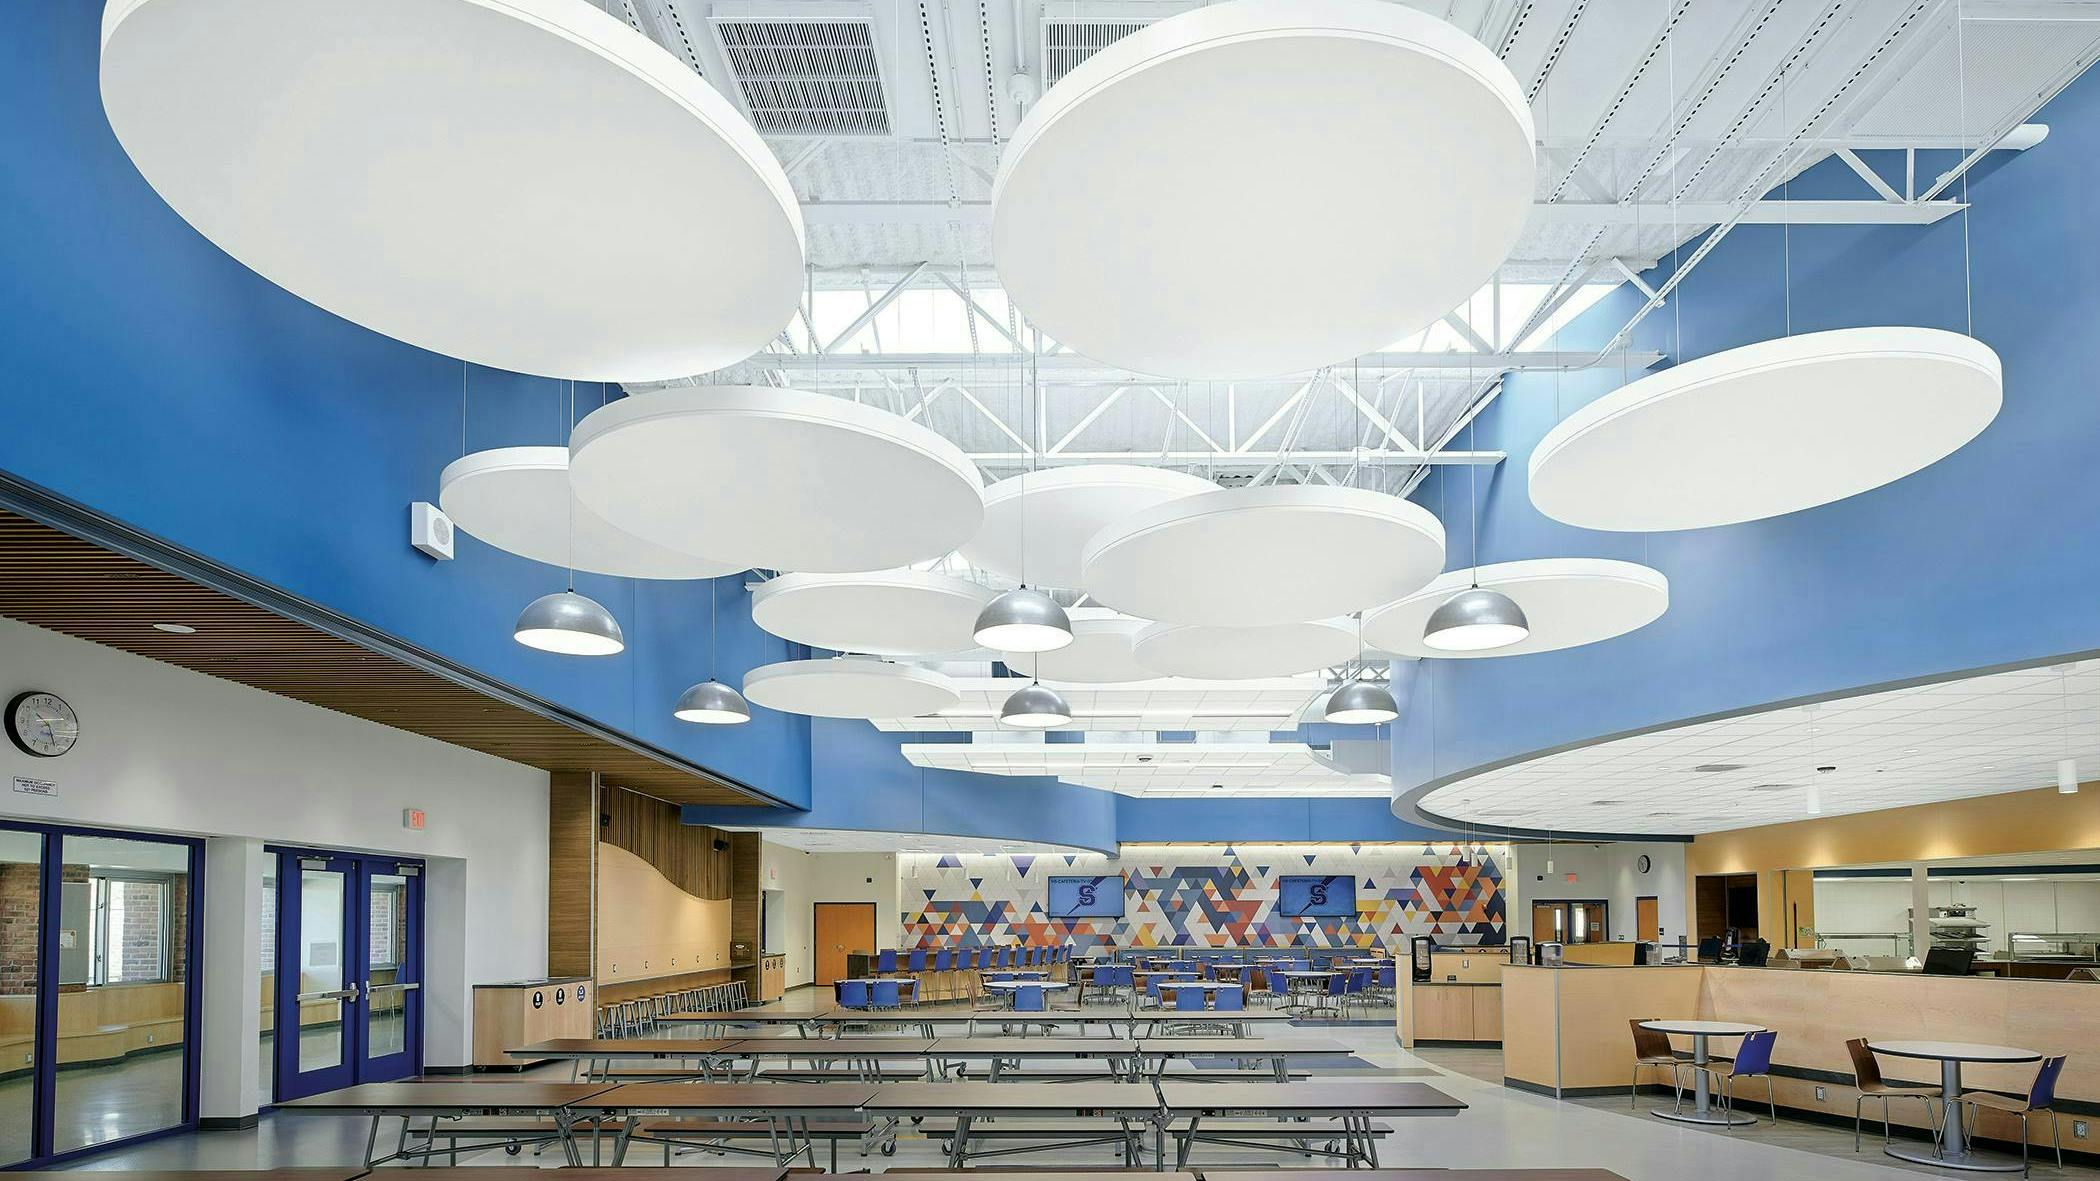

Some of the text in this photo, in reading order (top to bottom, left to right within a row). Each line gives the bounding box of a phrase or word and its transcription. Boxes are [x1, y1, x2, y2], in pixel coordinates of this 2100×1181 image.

[44, 697, 53, 706] 12
[1079, 885, 1096, 906] S
[1311, 885, 1327, 905] S
